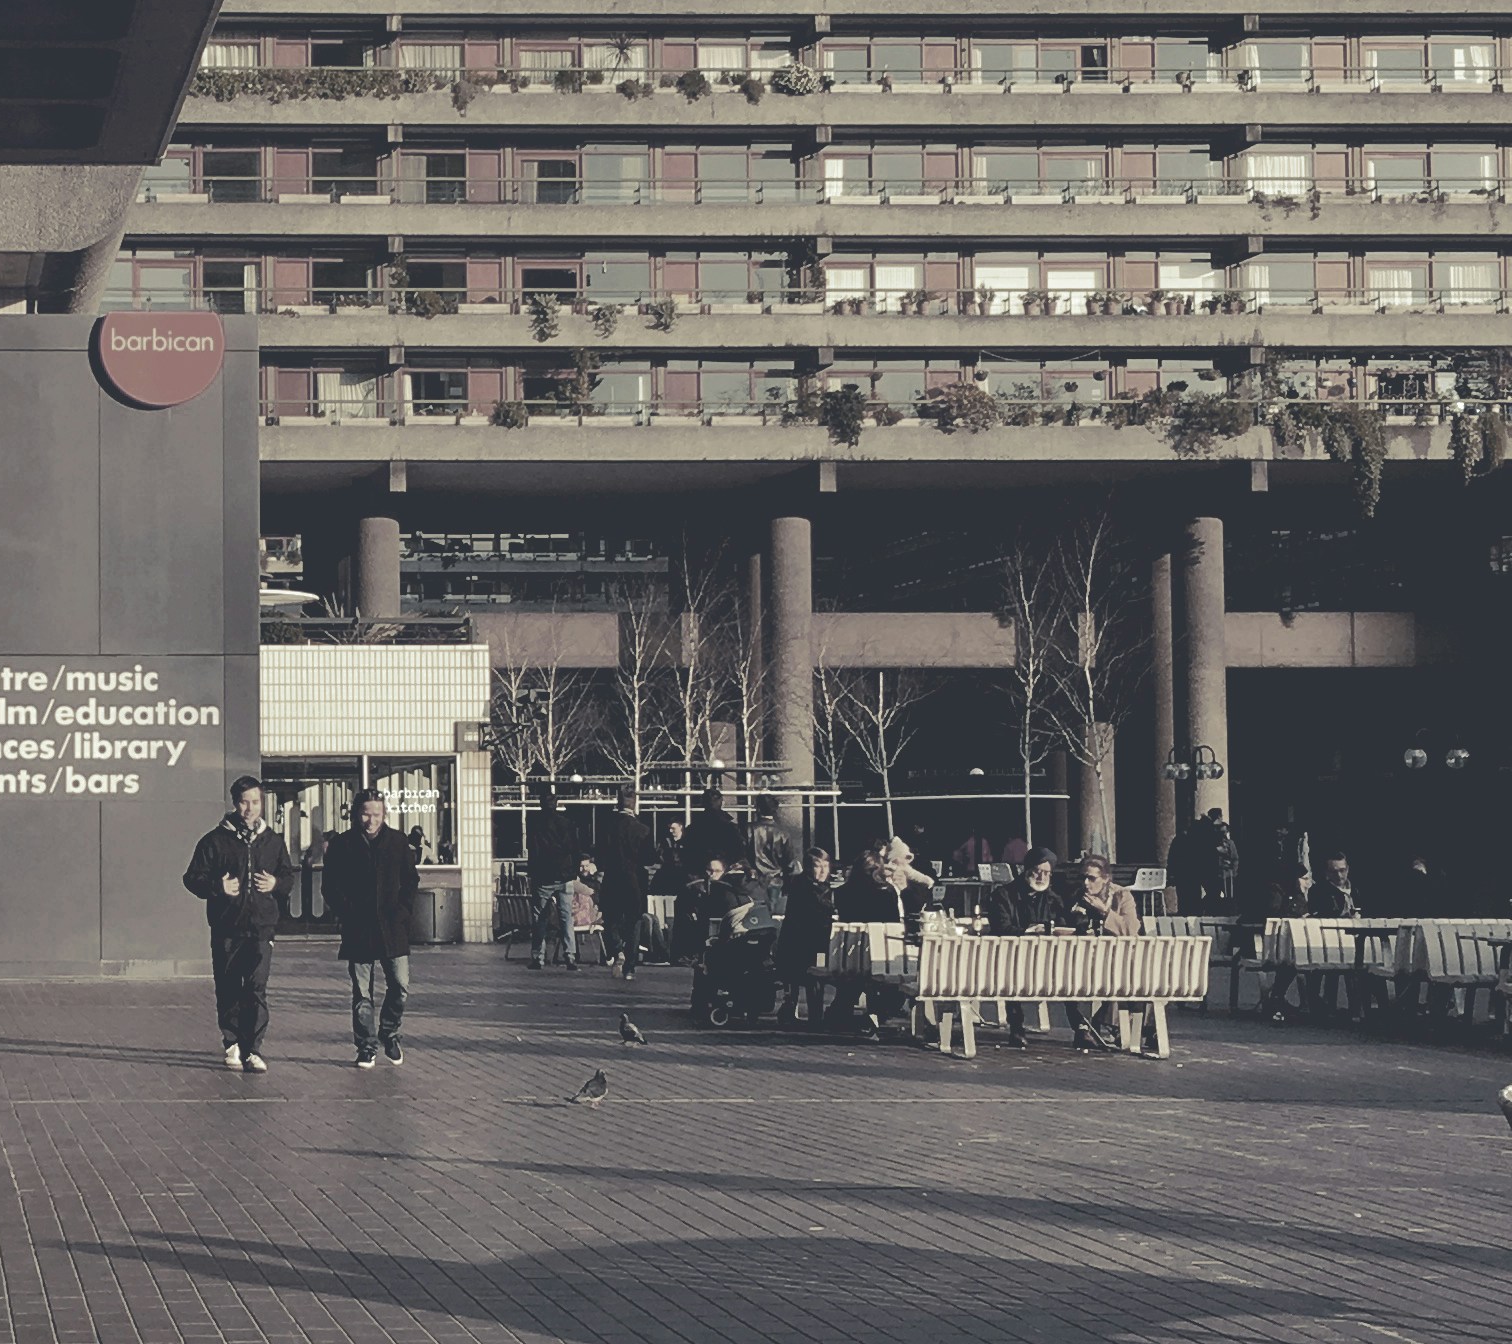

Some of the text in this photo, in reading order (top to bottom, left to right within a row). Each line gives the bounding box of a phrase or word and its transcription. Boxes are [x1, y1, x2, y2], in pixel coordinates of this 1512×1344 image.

[111, 327, 214, 352] barbican
[383, 787, 440, 799] barbican
[387, 801, 436, 813] kitchen
